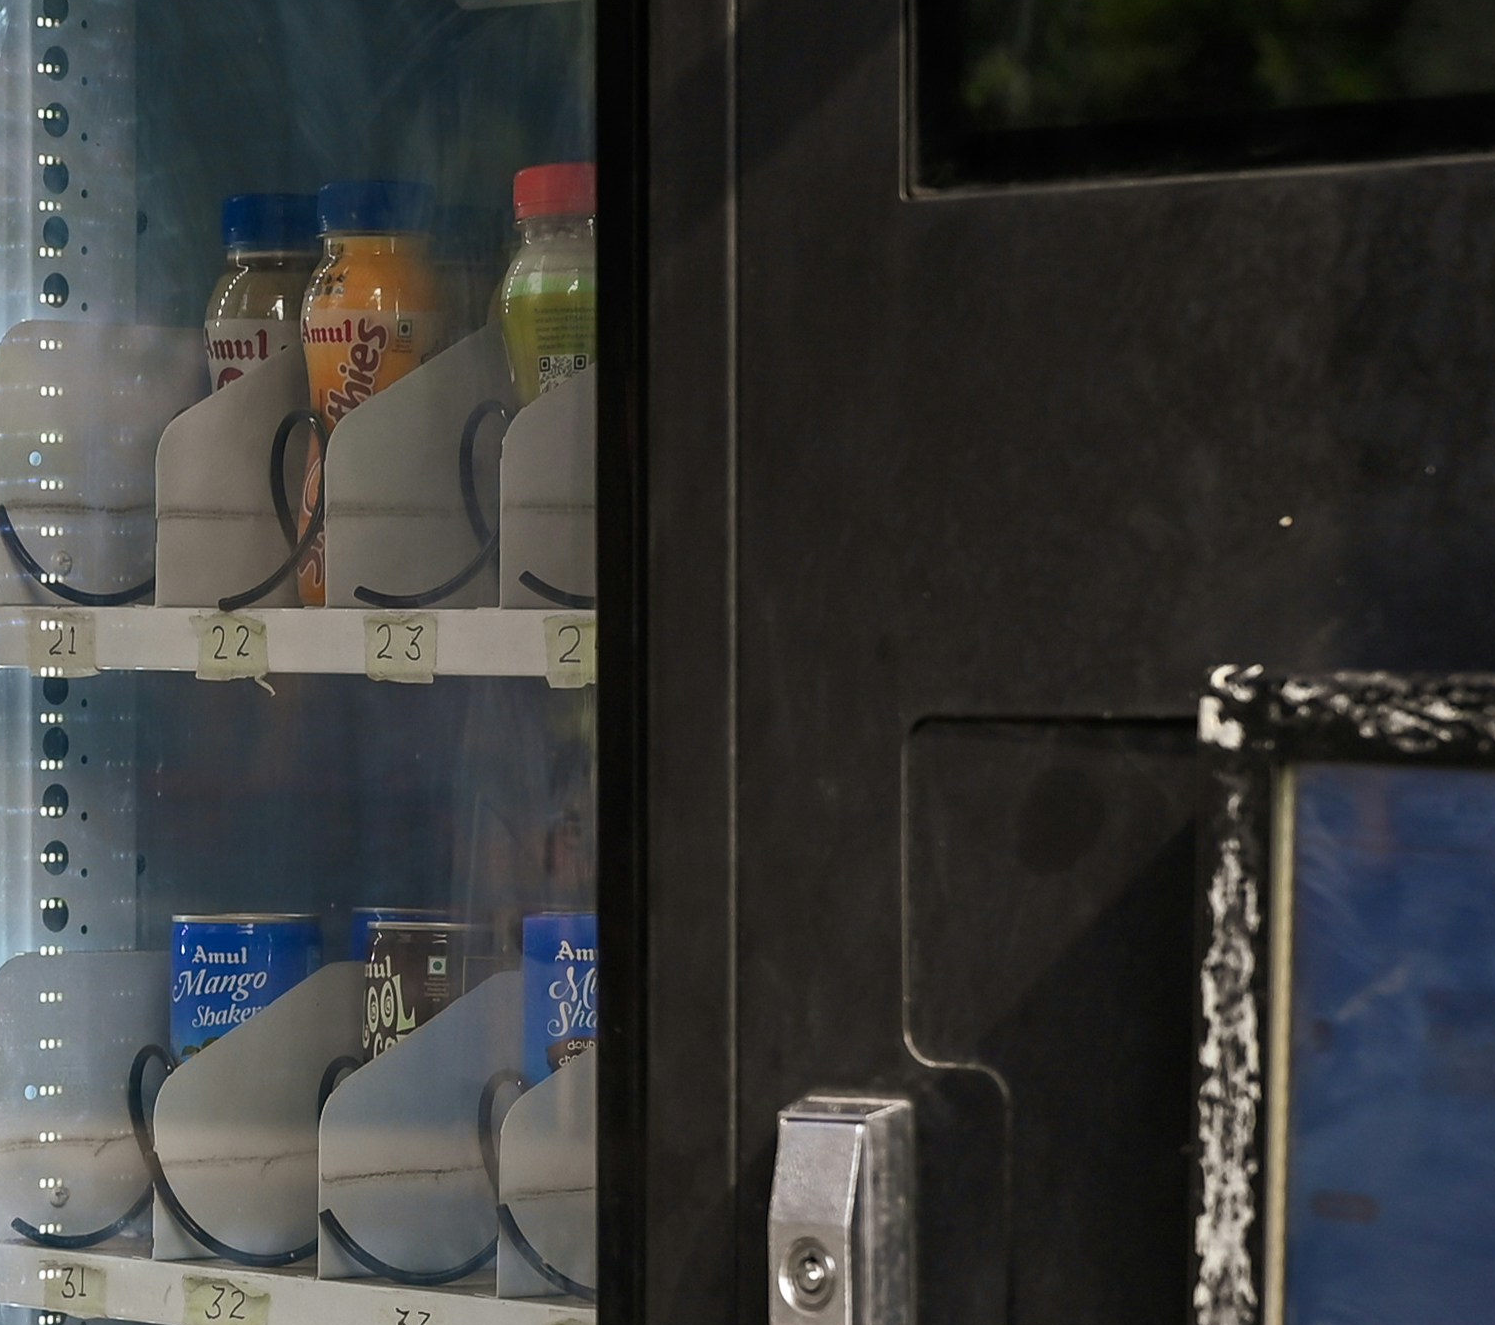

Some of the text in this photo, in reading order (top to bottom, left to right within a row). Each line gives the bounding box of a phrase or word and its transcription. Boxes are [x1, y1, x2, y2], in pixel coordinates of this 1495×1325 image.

[301, 318, 353, 345] Amul
[48, 624, 77, 656] 21
[211, 624, 252, 661] 22
[376, 625, 423, 662] 23
[191, 944, 248, 964] Amul
[555, 939, 597, 962] Am
[172, 968, 268, 1002] Mango
[363, 973, 416, 1049] OOL
[60, 1267, 87, 1299] 31
[204, 1284, 246, 1322] 32
